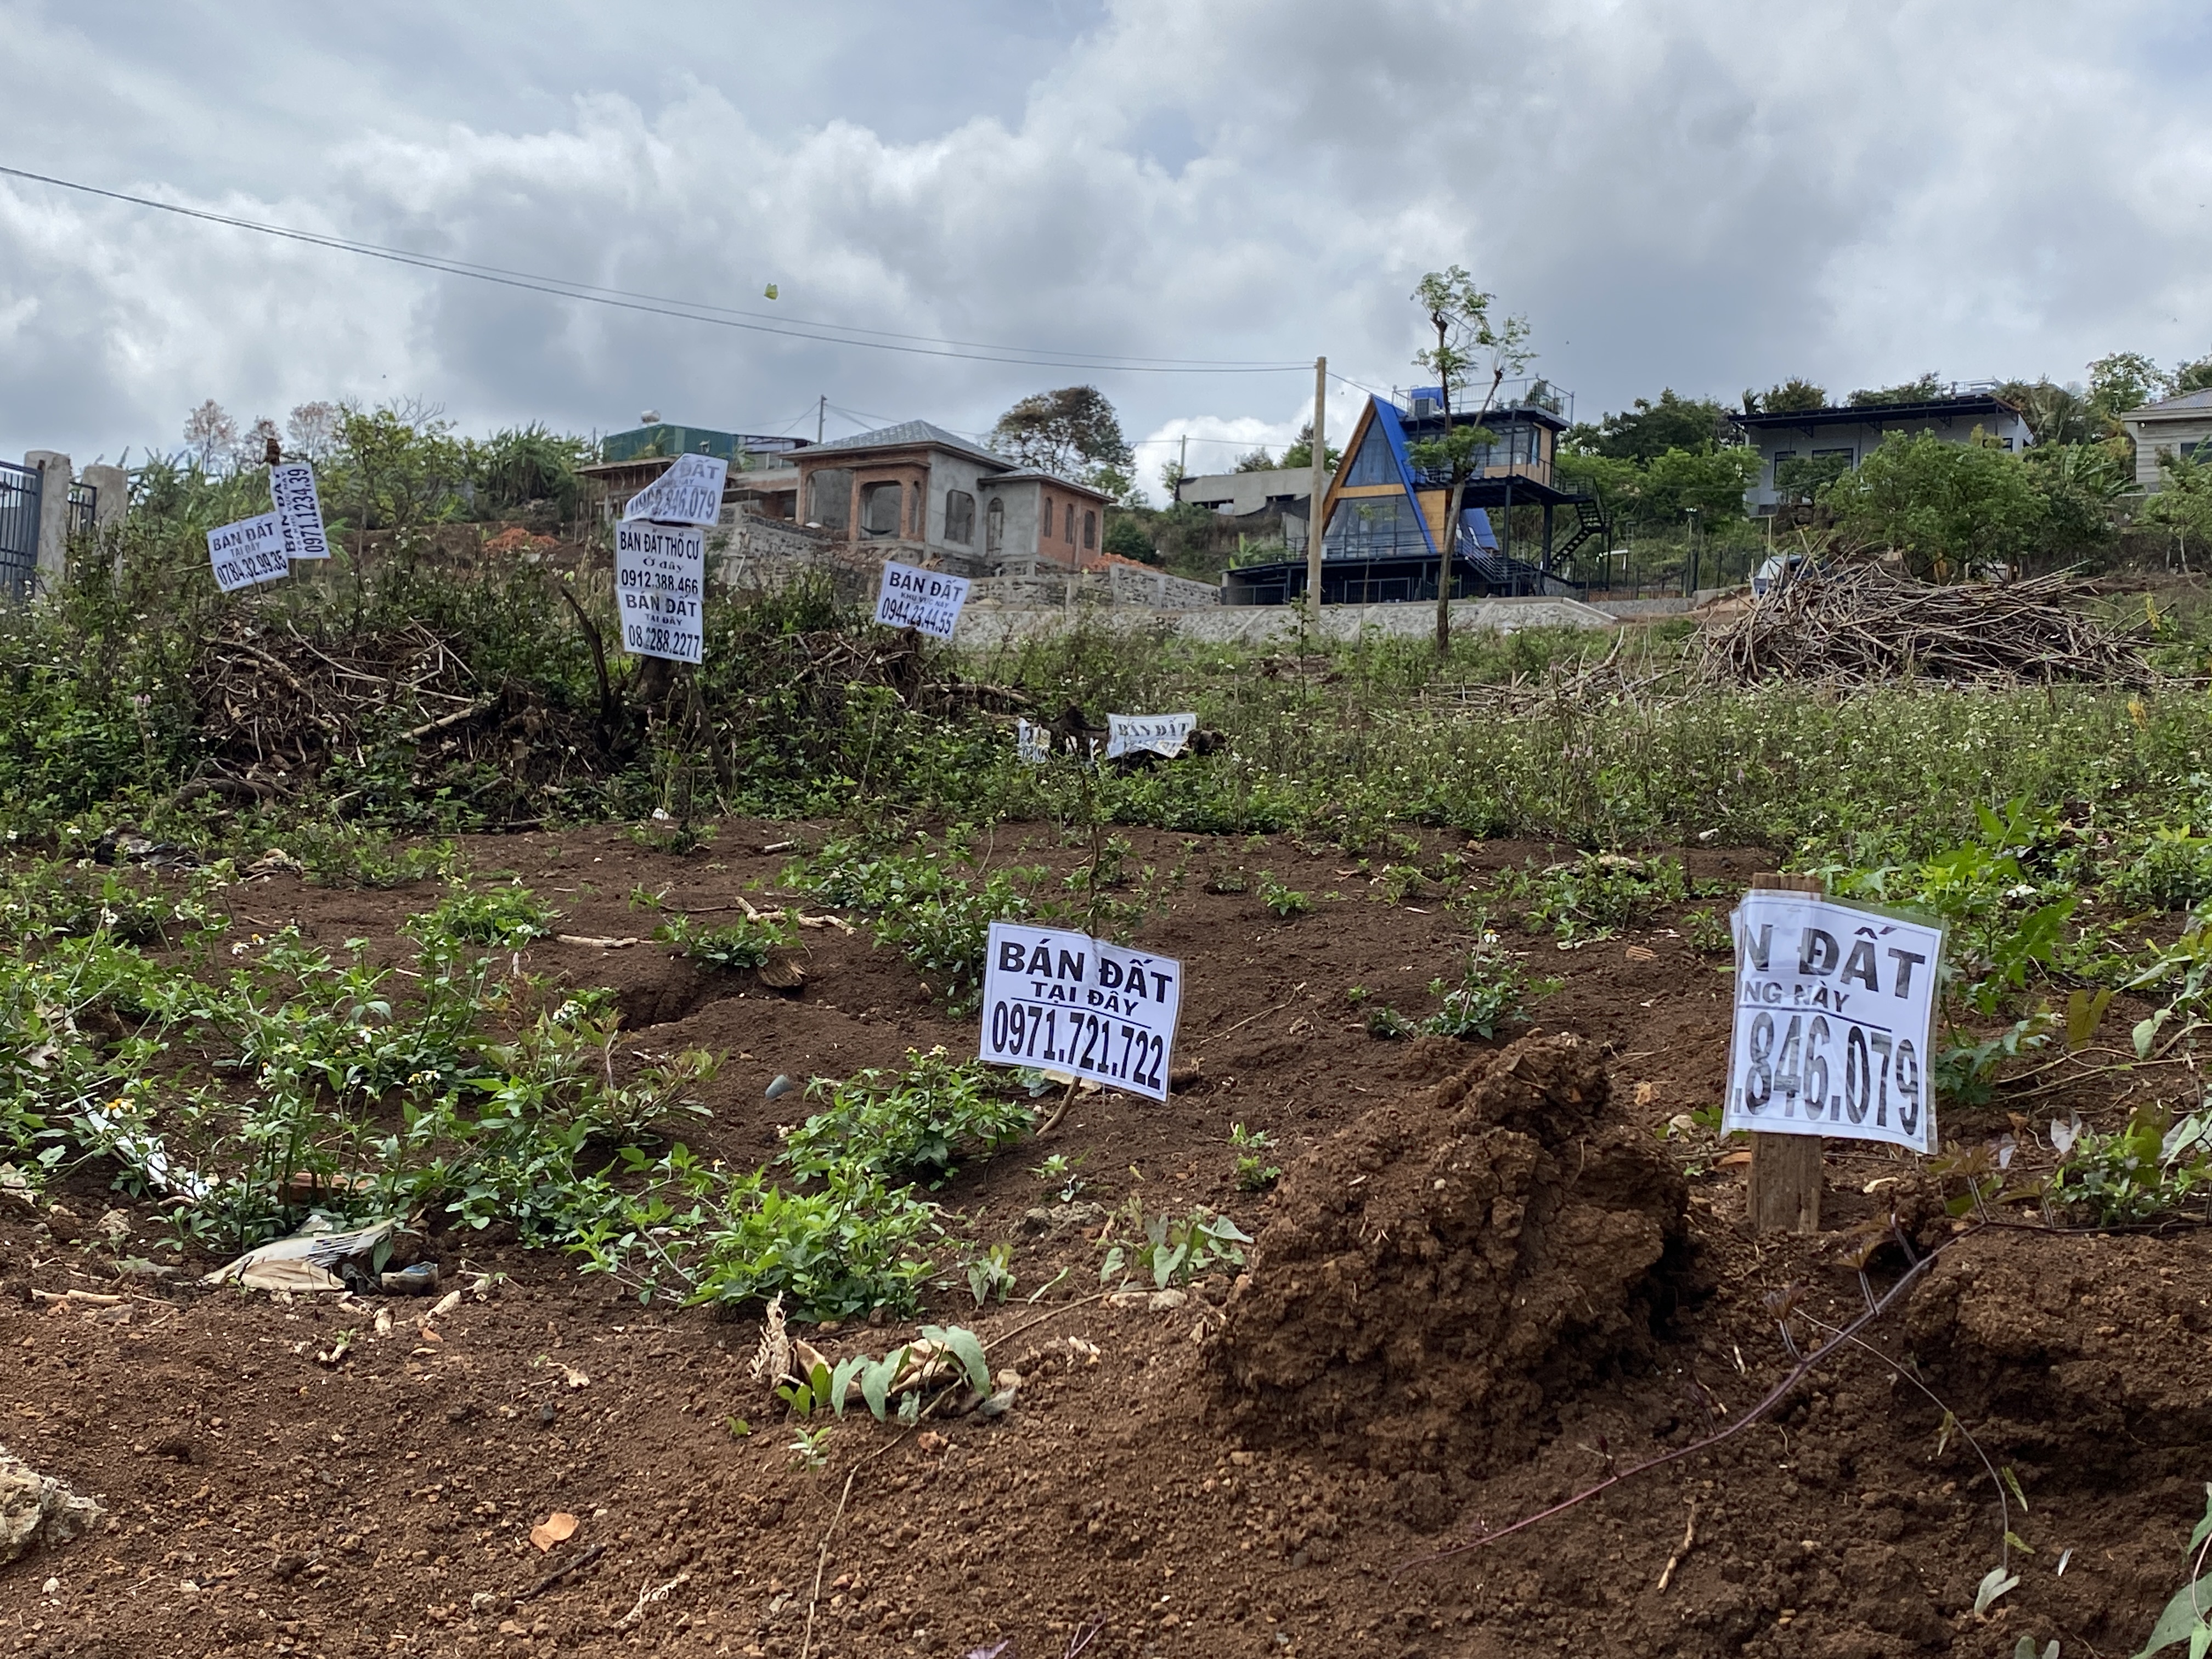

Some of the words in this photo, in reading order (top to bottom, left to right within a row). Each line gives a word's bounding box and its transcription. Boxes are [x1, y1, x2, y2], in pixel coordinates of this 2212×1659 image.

[287, 469, 325, 552] 0971.1234.39
[213, 532, 242, 551] BÁN
[245, 519, 273, 541] ĐẤT
[620, 524, 641, 552] BÁN
[665, 531, 684, 558] THỔ
[686, 537, 701, 560] CƯ
[216, 550, 287, 585] 0784.32.99.35
[621, 569, 698, 595] 0912.388.466
[625, 591, 660, 612] BÁN
[665, 594, 697, 617] ĐẤT
[889, 571, 926, 594] BÁN
[930, 579, 963, 602] ĐẤT
[901, 592, 917, 601] KHU
[882, 597, 954, 634] 0944.23.44.55
[1155, 716, 1189, 737] ĐẤT
[998, 938, 1085, 982] BÁN
[1098, 958, 1173, 1003] ĐẤT
[1797, 926, 1926, 1000] ĐẤT
[1030, 980, 1076, 1003] TẠI
[1087, 989, 1139, 1017] ĐÂY
[1741, 980, 1782, 1004] NG
[1793, 980, 1850, 1013] NÀY
[992, 1000, 1164, 1090] 0971.721.722
